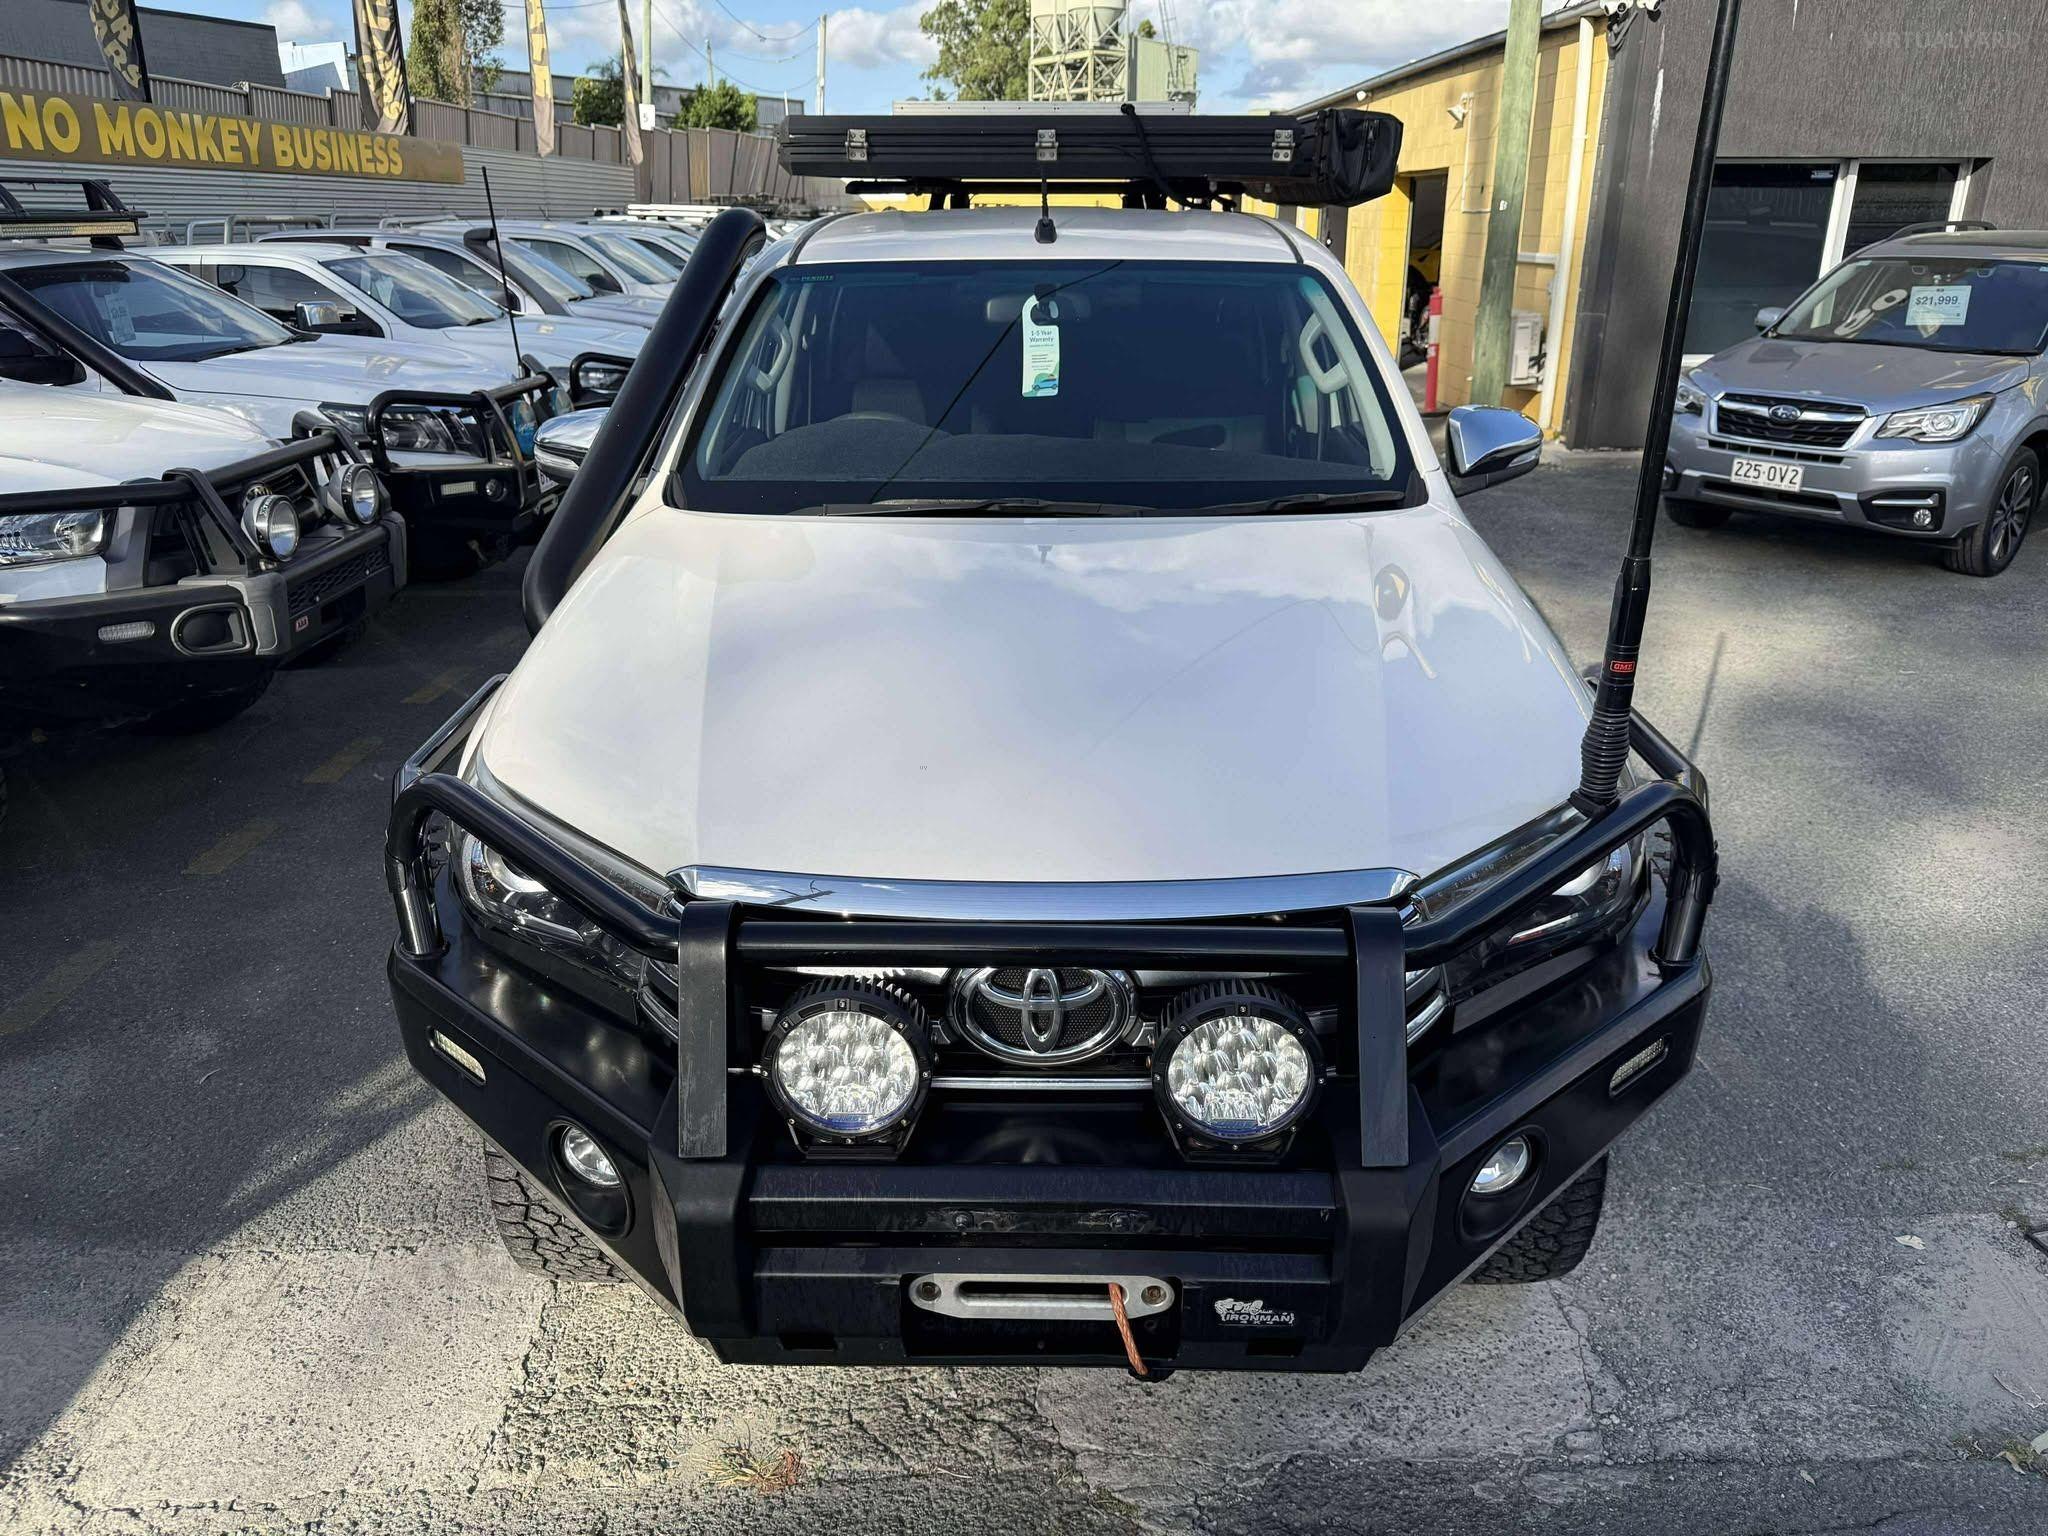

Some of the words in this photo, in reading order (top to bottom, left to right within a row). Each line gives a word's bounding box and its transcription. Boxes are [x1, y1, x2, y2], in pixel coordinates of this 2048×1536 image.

[0, 92, 81, 153] NO
[93, 102, 262, 165] MONKEY
[271, 123, 404, 176] BUSINESS
[1225, 1313, 1291, 1322] IRONMAN
